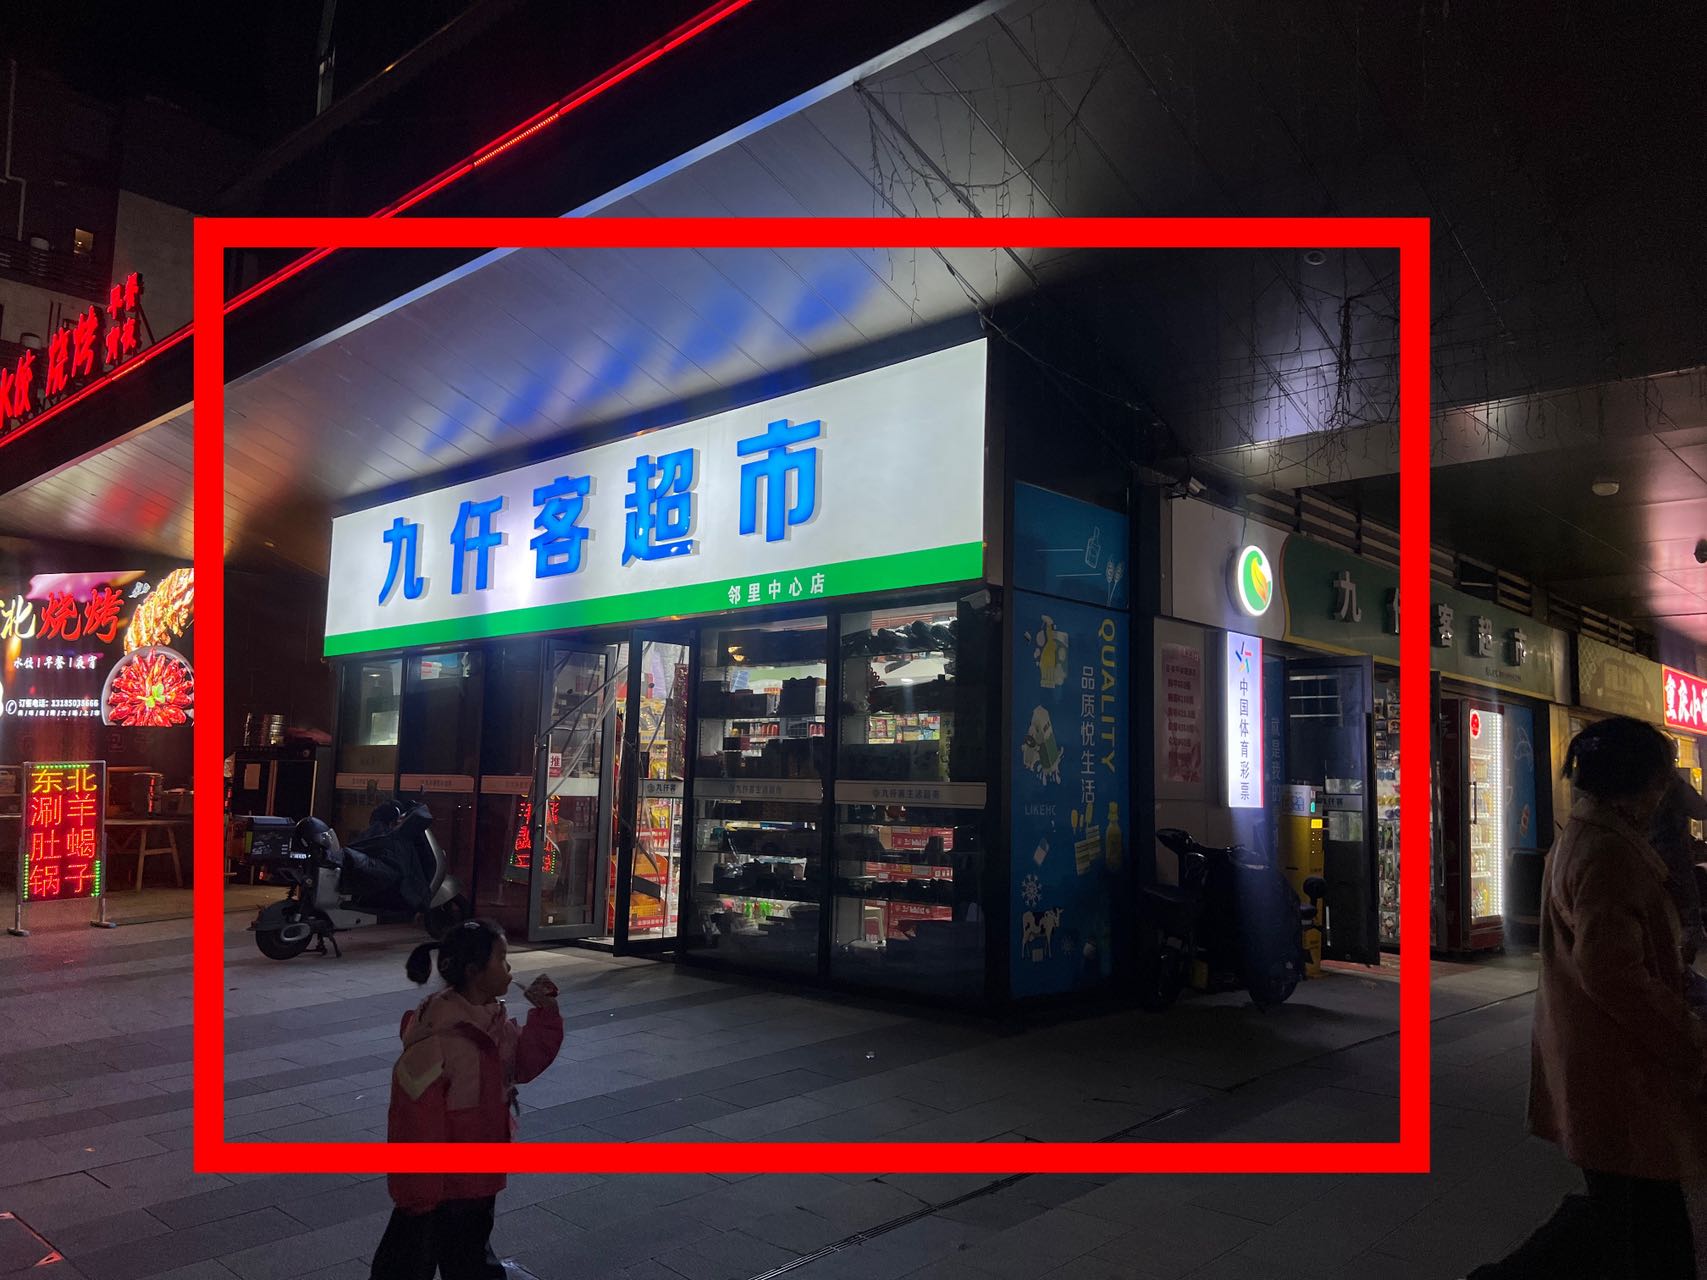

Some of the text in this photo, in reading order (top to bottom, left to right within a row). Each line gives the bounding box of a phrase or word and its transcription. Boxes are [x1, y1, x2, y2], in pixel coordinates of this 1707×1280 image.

[46, 304, 99, 397] 烧烤
[378, 418, 824, 606] 九仟客超市
[0, 587, 125, 644] 北烧烤
[727, 572, 825, 605] 邻里中心店
[1080, 665, 1096, 804] 品质悦生活
[1098, 618, 1116, 773] QUALITY
[1239, 678, 1250, 800] 中国体育彩票
[31, 768, 98, 794] 东北
[550, 755, 561, 767] 推
[28, 795, 63, 897] 涮肚锅
[64, 794, 98, 894] 羊蝎子
